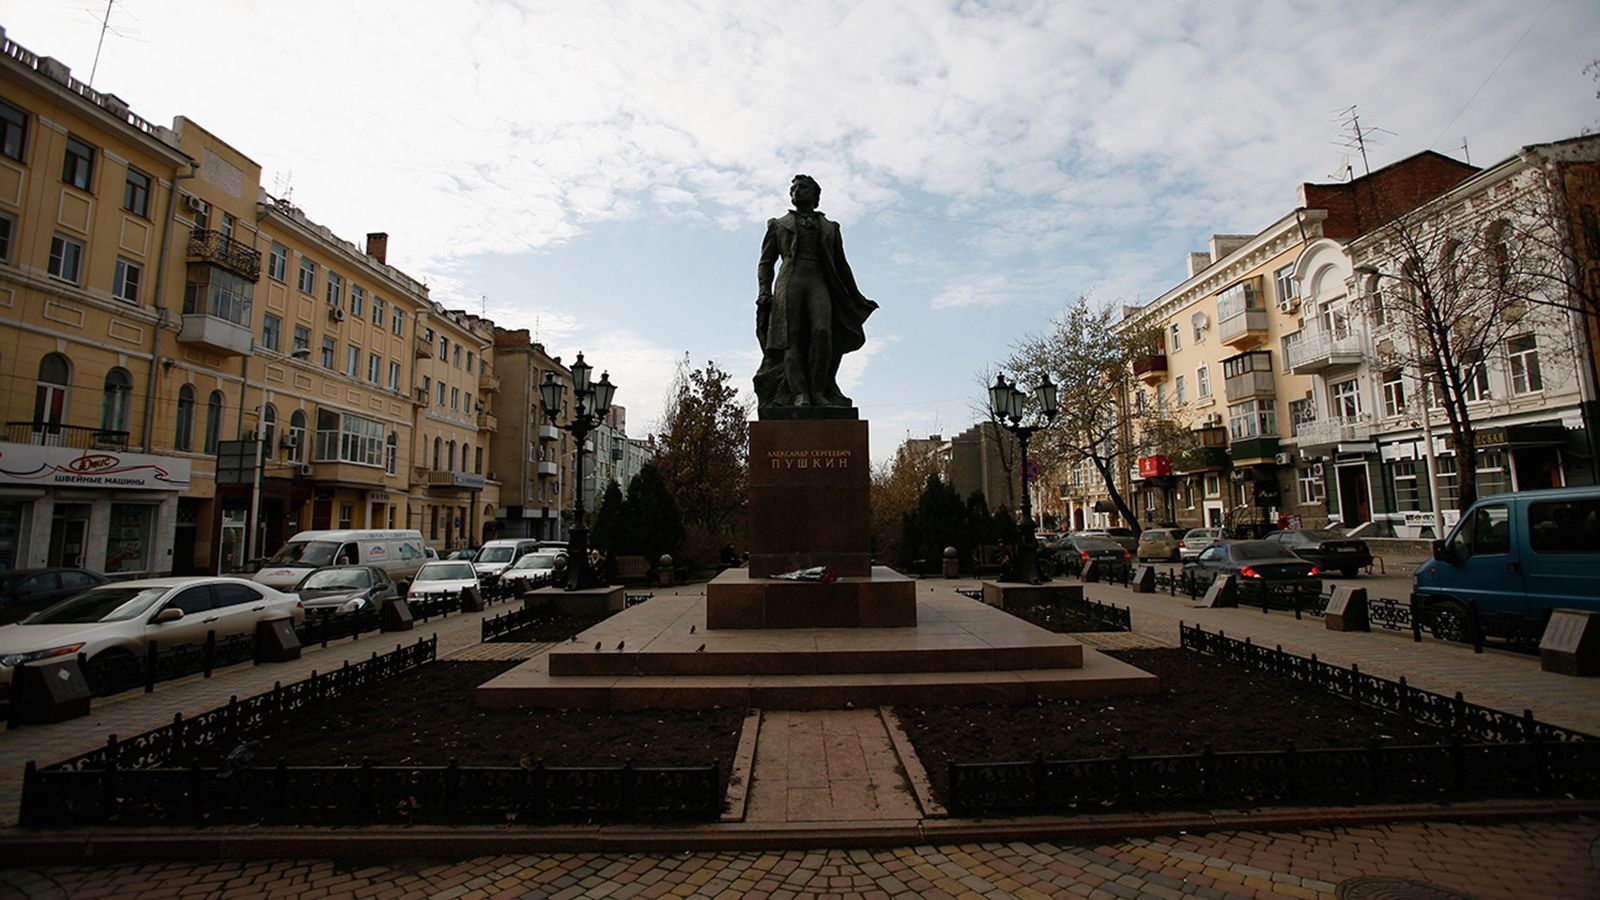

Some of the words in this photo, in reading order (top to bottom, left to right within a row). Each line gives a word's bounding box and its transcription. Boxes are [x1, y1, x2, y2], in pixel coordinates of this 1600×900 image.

[811, 449, 851, 457] СЕРГЕЕВИЧ
[772, 458, 848, 469] ПУШКИН
[55, 475, 102, 484] ШВЕЙНЫЕ
[104, 477, 145, 486] МАШИНЫ
